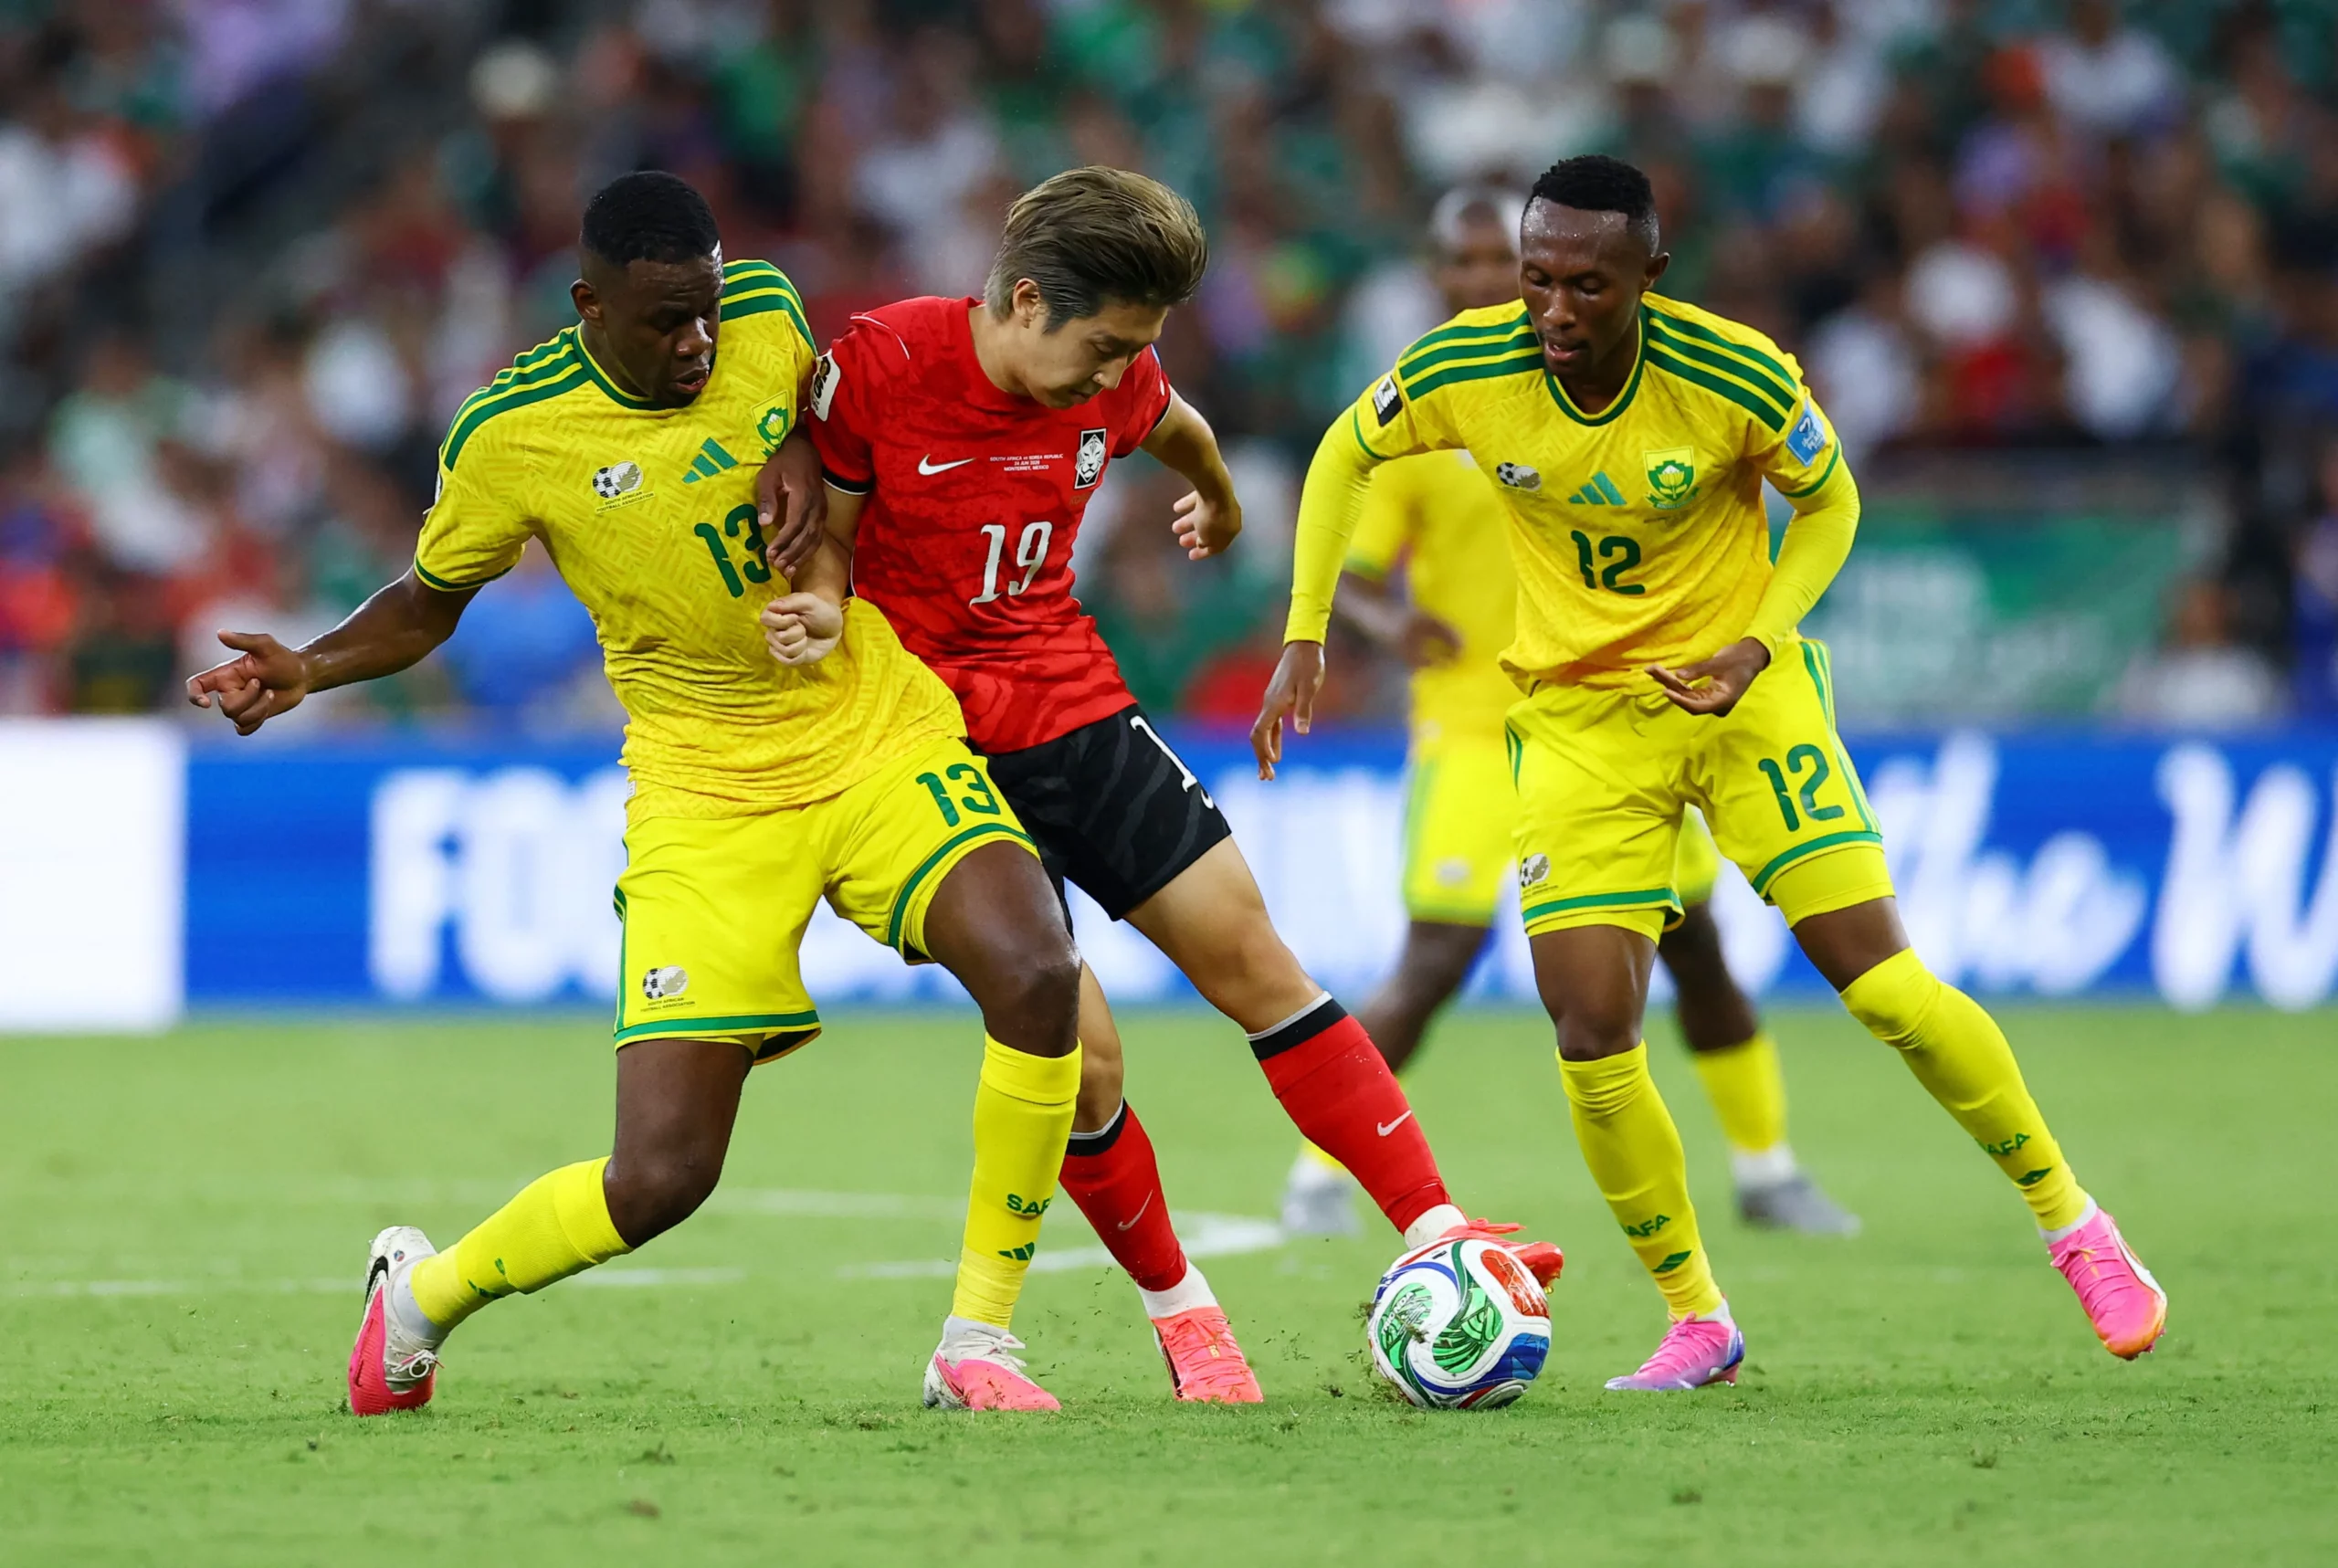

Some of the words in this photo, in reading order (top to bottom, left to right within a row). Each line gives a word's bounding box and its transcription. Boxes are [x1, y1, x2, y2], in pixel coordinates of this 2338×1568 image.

[694, 503, 772, 598] 13
[969, 521, 1052, 607] 19
[1571, 530, 1646, 595] 12
[1130, 715, 1215, 809] 1
[1758, 743, 1845, 832] 12
[916, 763, 1001, 827] 13
[1975, 1132, 2031, 1156] AFA
[1006, 1193, 1053, 1215] SAF
[1622, 1214, 1670, 1237] AFA
